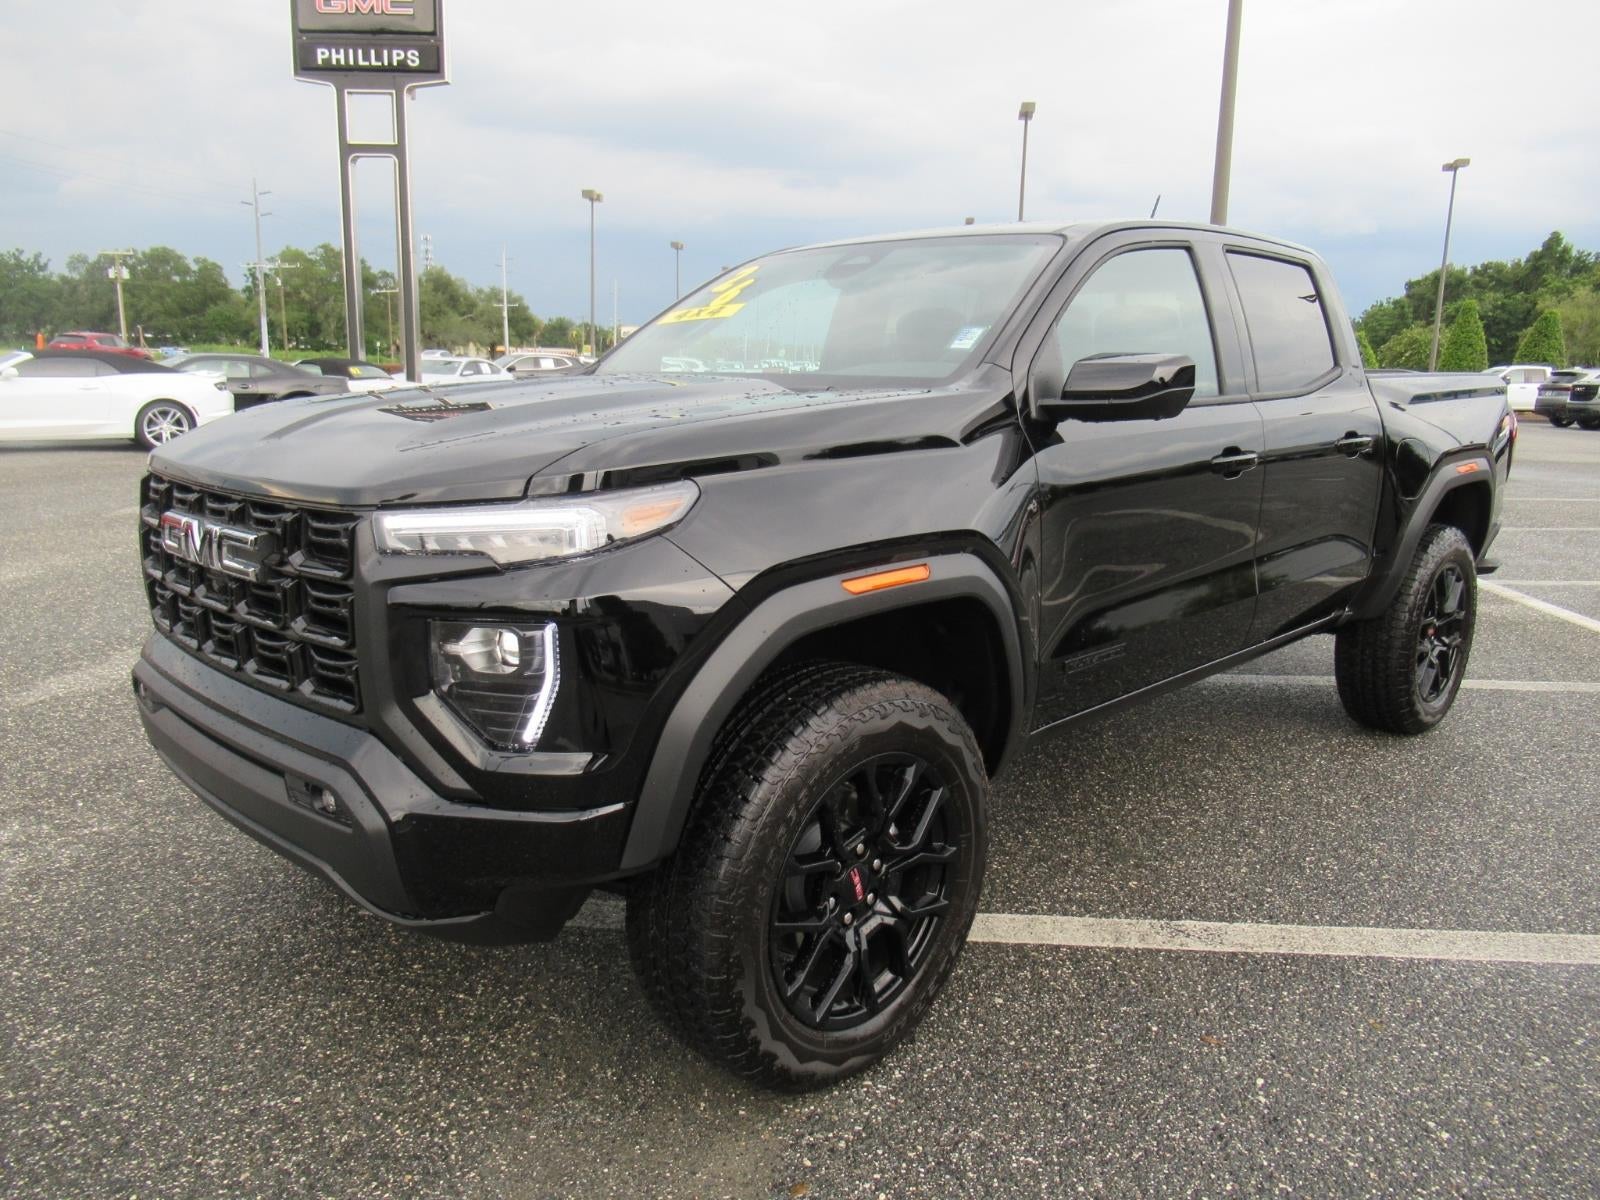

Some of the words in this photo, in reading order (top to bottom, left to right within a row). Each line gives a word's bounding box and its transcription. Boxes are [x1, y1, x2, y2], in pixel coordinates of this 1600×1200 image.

[315, 0, 414, 14] GMC
[316, 47, 420, 67] PHILLIPS
[160, 508, 258, 581] GMC
